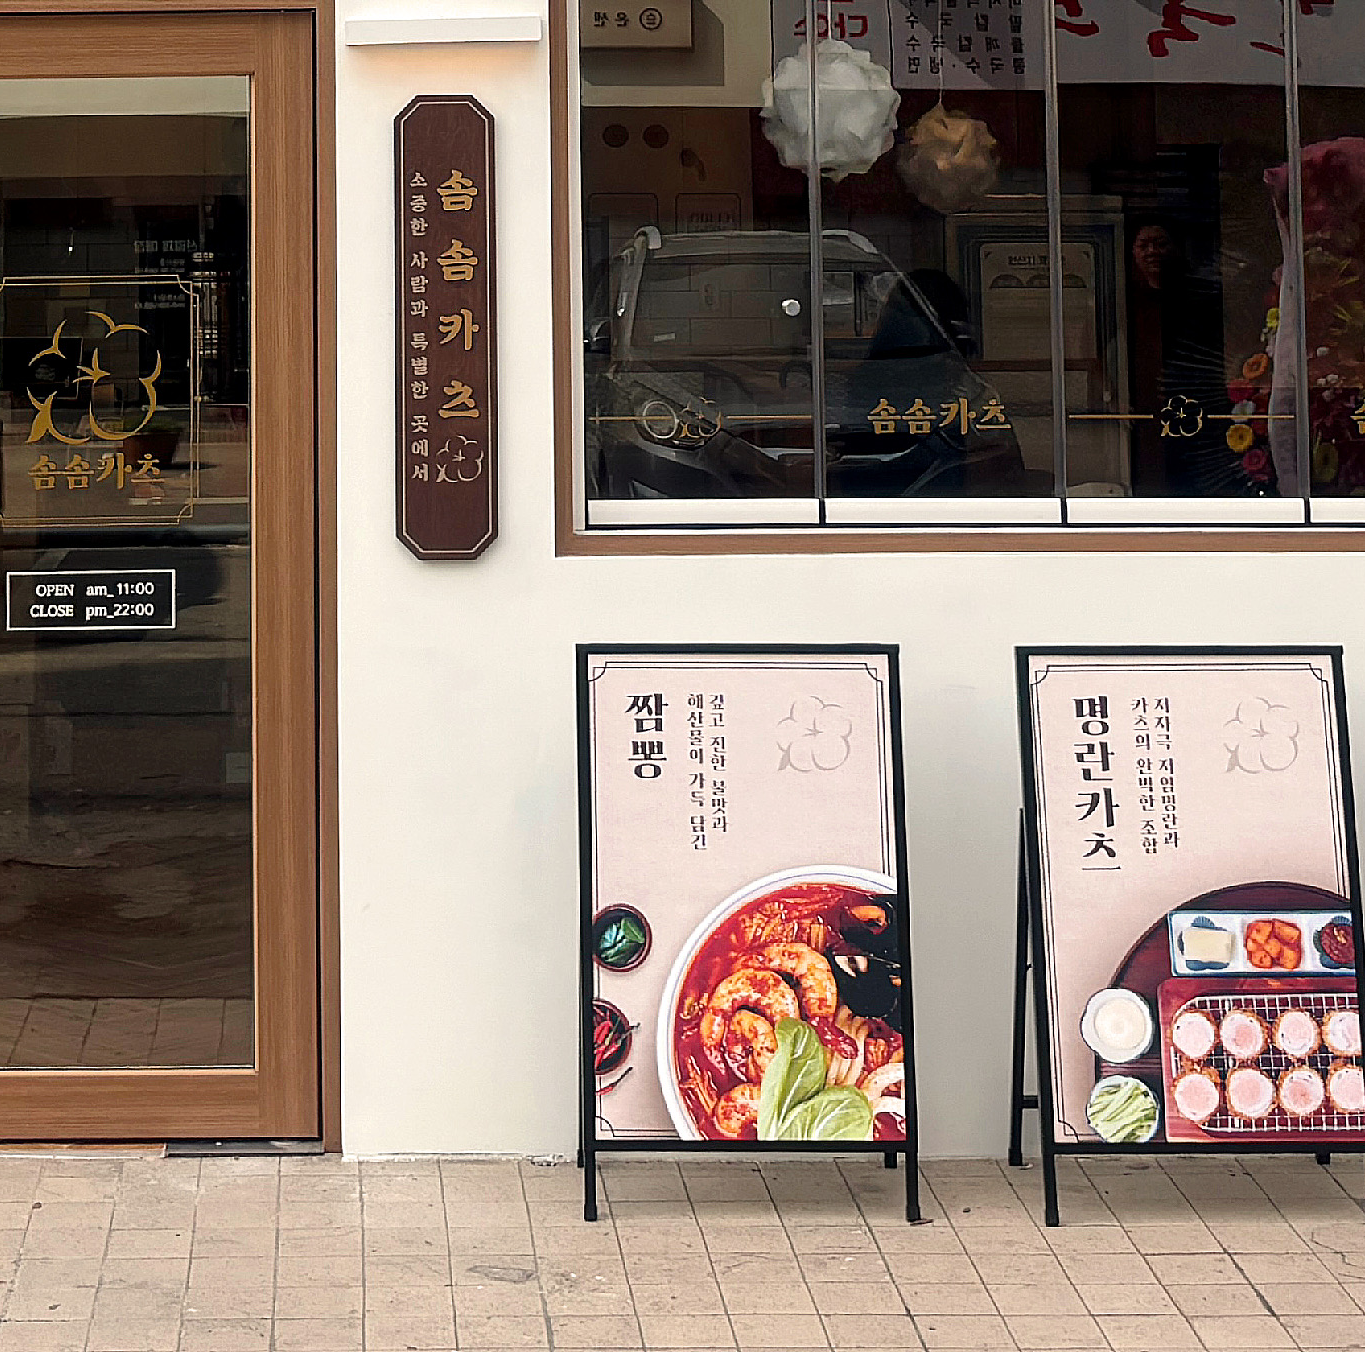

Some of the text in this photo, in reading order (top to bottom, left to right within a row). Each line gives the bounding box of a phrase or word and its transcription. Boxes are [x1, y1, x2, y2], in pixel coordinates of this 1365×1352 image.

[409, 171, 430, 483] 소중한 사람과 특별한 곳에서
[436, 168, 480, 419] 솜솜카츠
[28, 452, 165, 490] 솜솜카츠
[867, 397, 1012, 435] 솜솜카츠
[29, 603, 75, 618] CLOSE
[35, 583, 75, 597] OPEN
[625, 693, 669, 779] 짬뽕
[687, 693, 707, 851] 해산물이 가득 담긴
[708, 694, 728, 833] 깊고 진한 불맛과
[1073, 695, 1121, 871] 명란카츠
[1131, 697, 1158, 855] 카츠의 완벽한 조합
